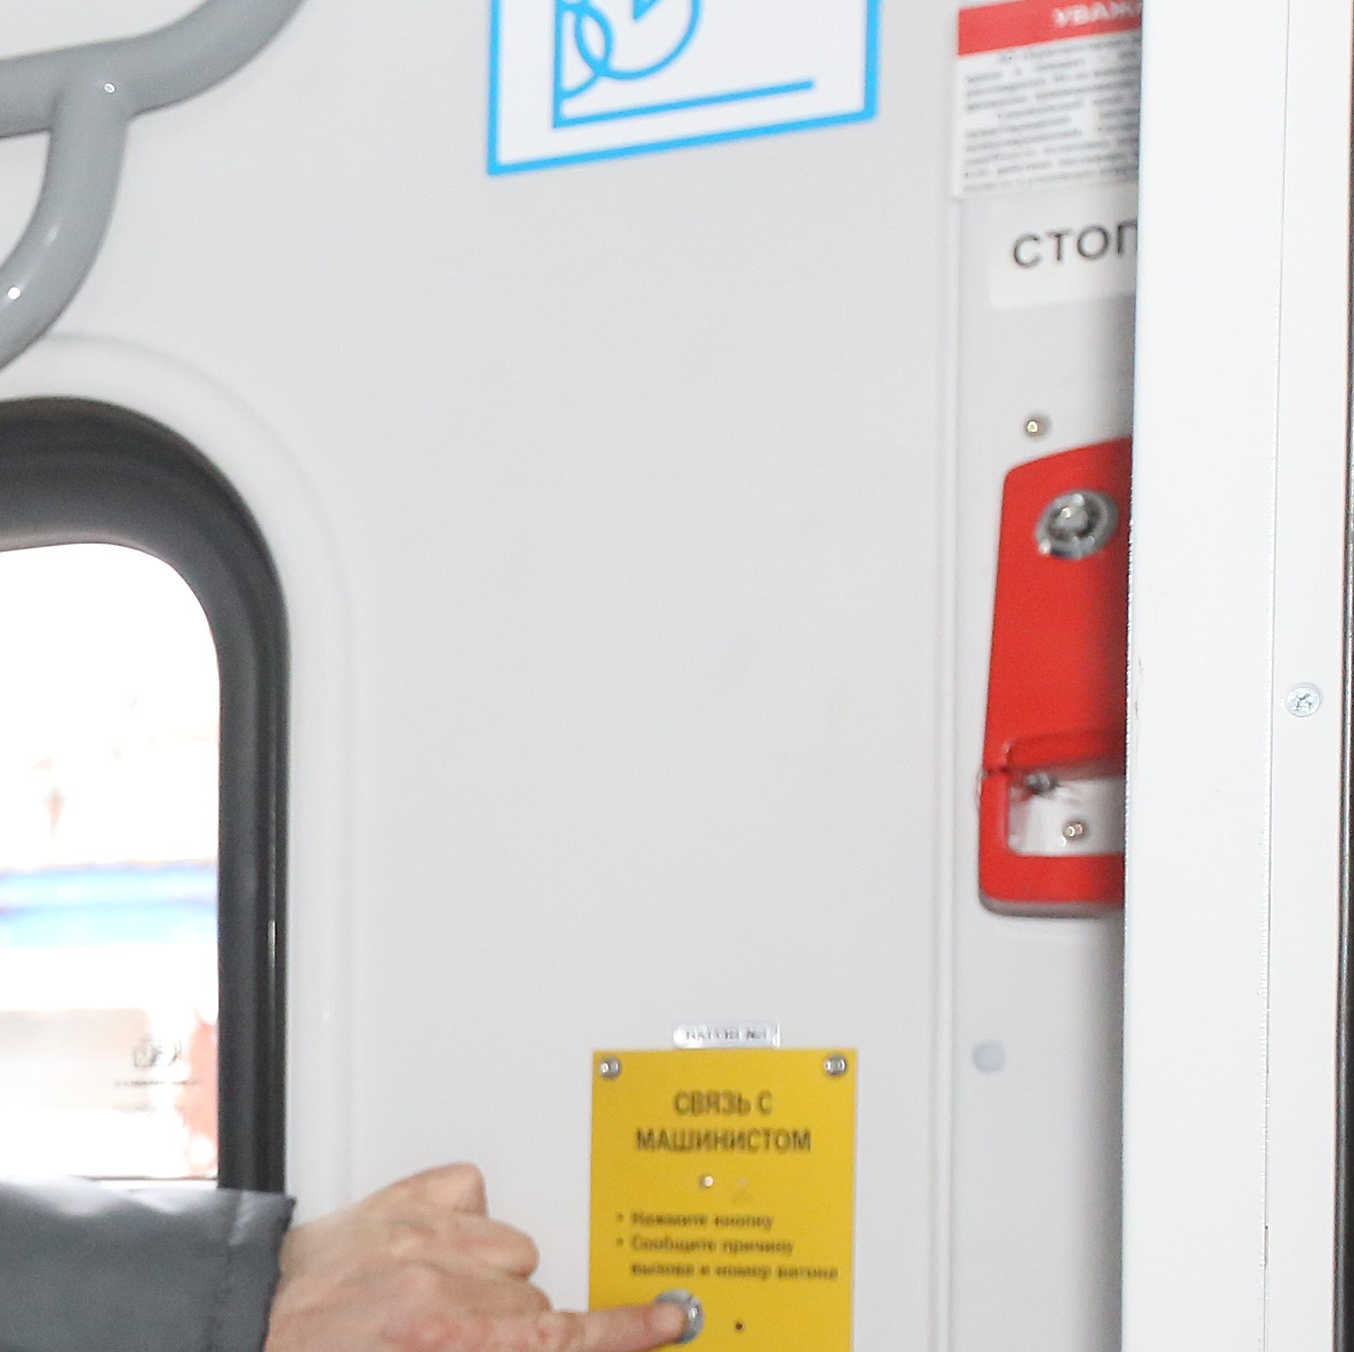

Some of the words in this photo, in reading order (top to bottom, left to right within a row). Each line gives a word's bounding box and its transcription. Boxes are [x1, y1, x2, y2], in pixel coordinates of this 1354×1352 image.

[674, 1091, 750, 1116] СВЯЗЬ
[758, 1091, 773, 1116] С
[637, 1128, 811, 1153] МАШИНИСТОМ
